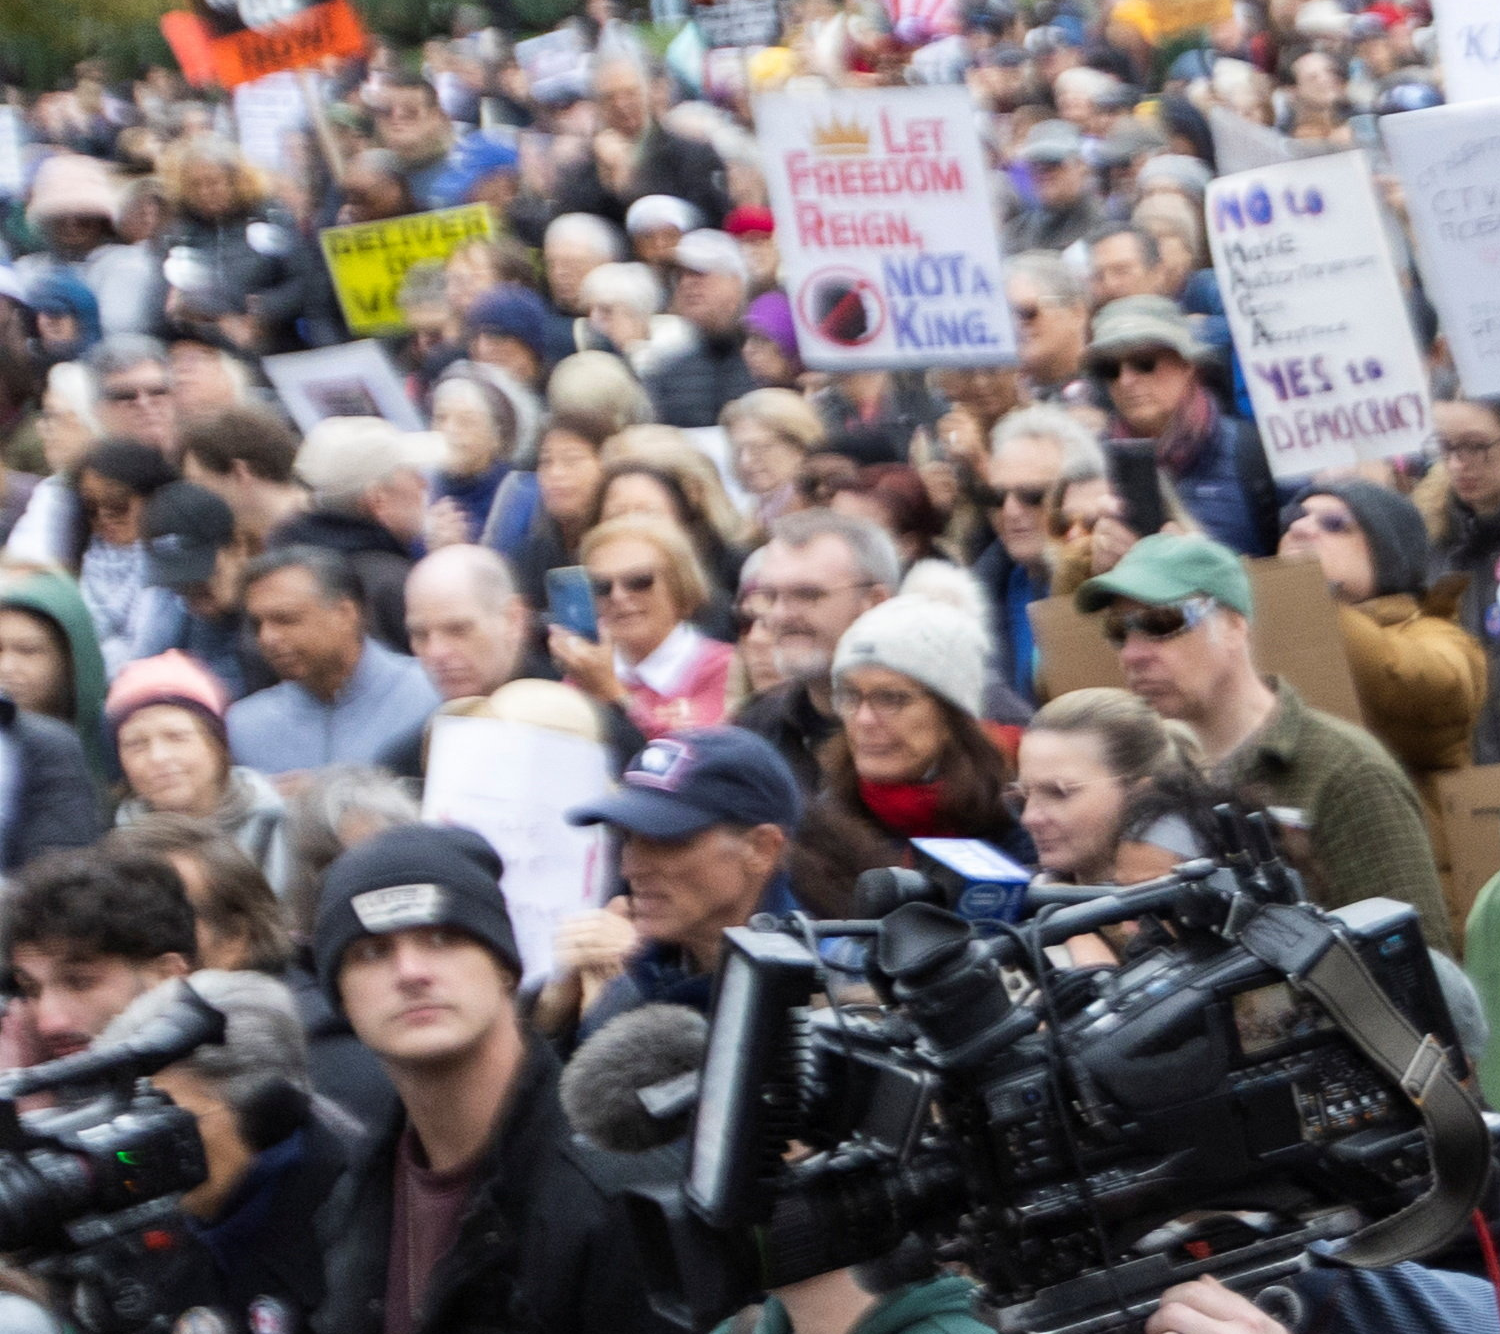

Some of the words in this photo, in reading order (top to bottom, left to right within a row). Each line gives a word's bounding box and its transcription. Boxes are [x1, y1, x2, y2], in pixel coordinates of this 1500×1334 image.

[784, 149, 964, 196] FREEDOM
[1214, 180, 1273, 233] NO
[882, 252, 966, 297] NOT
[1252, 354, 1334, 402] YES
[1266, 393, 1425, 452] DEMOCRACY
